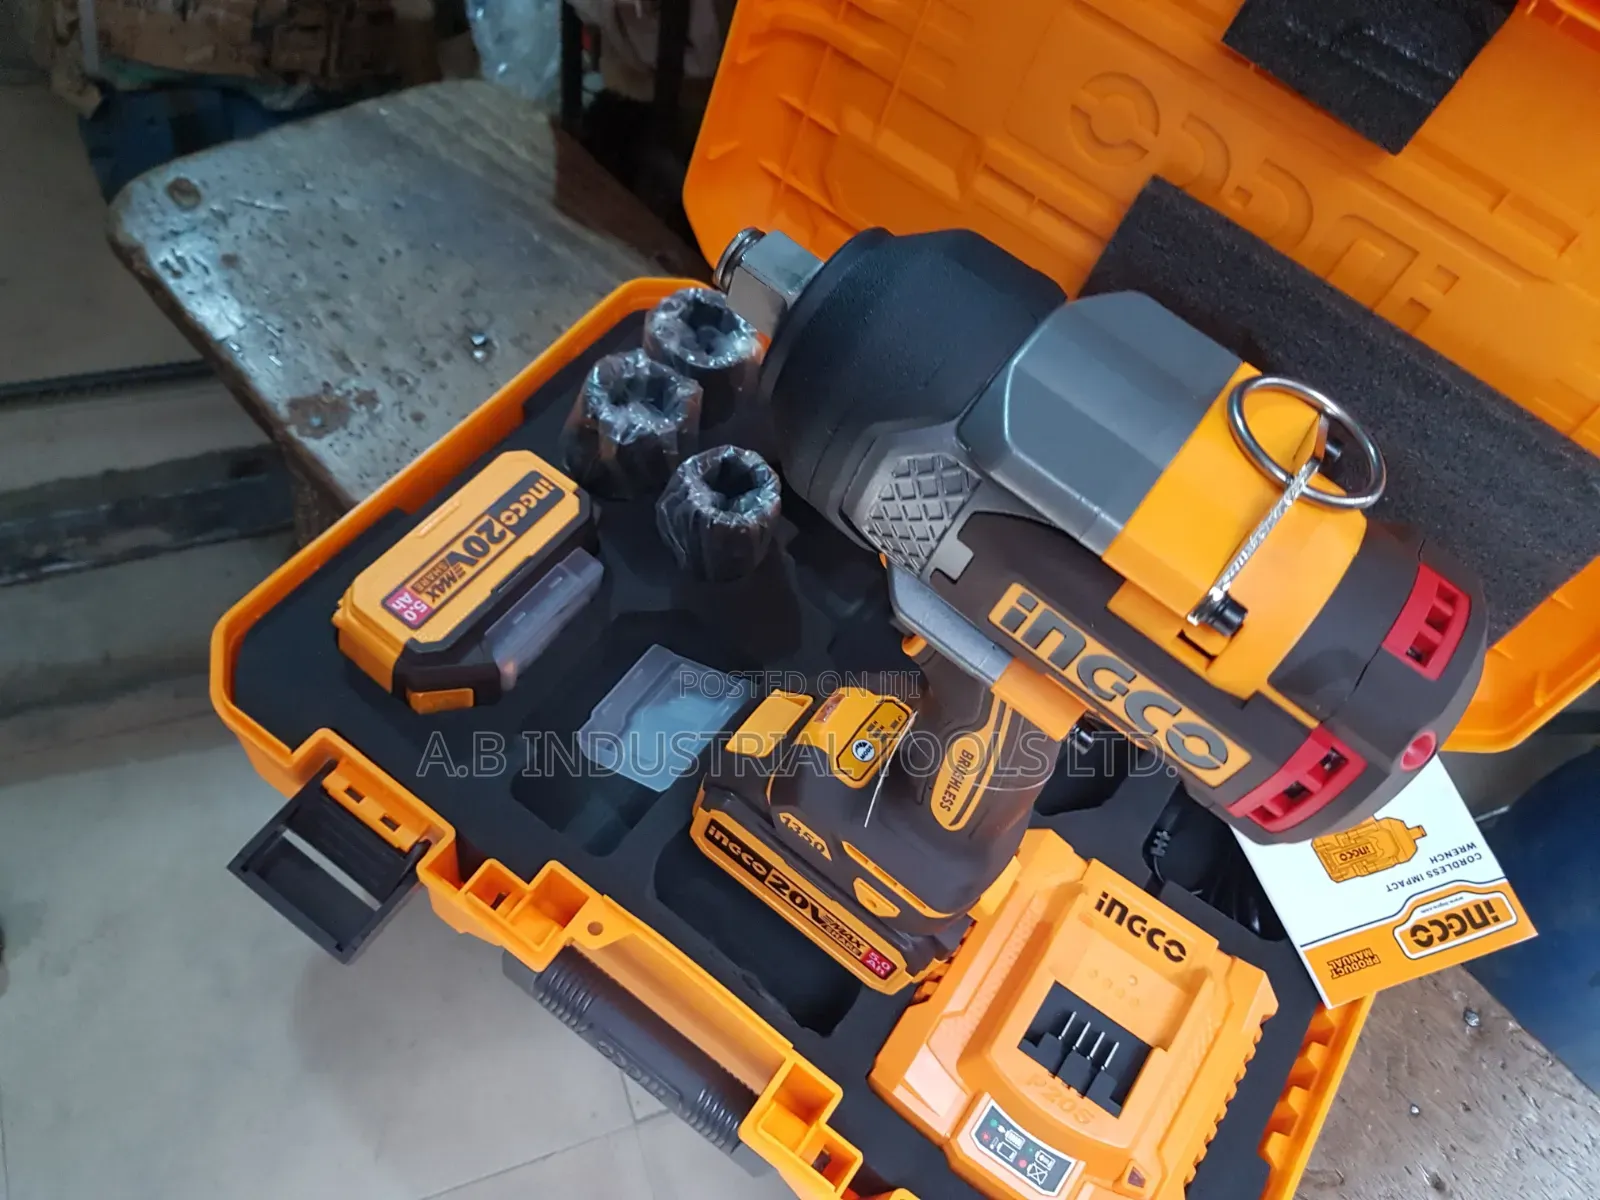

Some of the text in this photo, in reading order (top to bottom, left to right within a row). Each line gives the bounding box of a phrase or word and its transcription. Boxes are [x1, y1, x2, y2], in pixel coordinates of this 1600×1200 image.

[445, 517, 507, 567] 20V
[426, 567, 458, 603] MAX
[391, 591, 413, 610] Ah
[402, 599, 428, 621] 5.0
[1429, 841, 1477, 865] WRENCH
[1386, 852, 1483, 893] CORDLESS IMPACT
[767, 873, 825, 926] 20V
[832, 921, 866, 949] MAX
[866, 959, 886, 976] Ah
[868, 951, 891, 971] 5.0
[1327, 947, 1374, 971] MANUAL
[1331, 954, 1381, 980] PRODUCT
